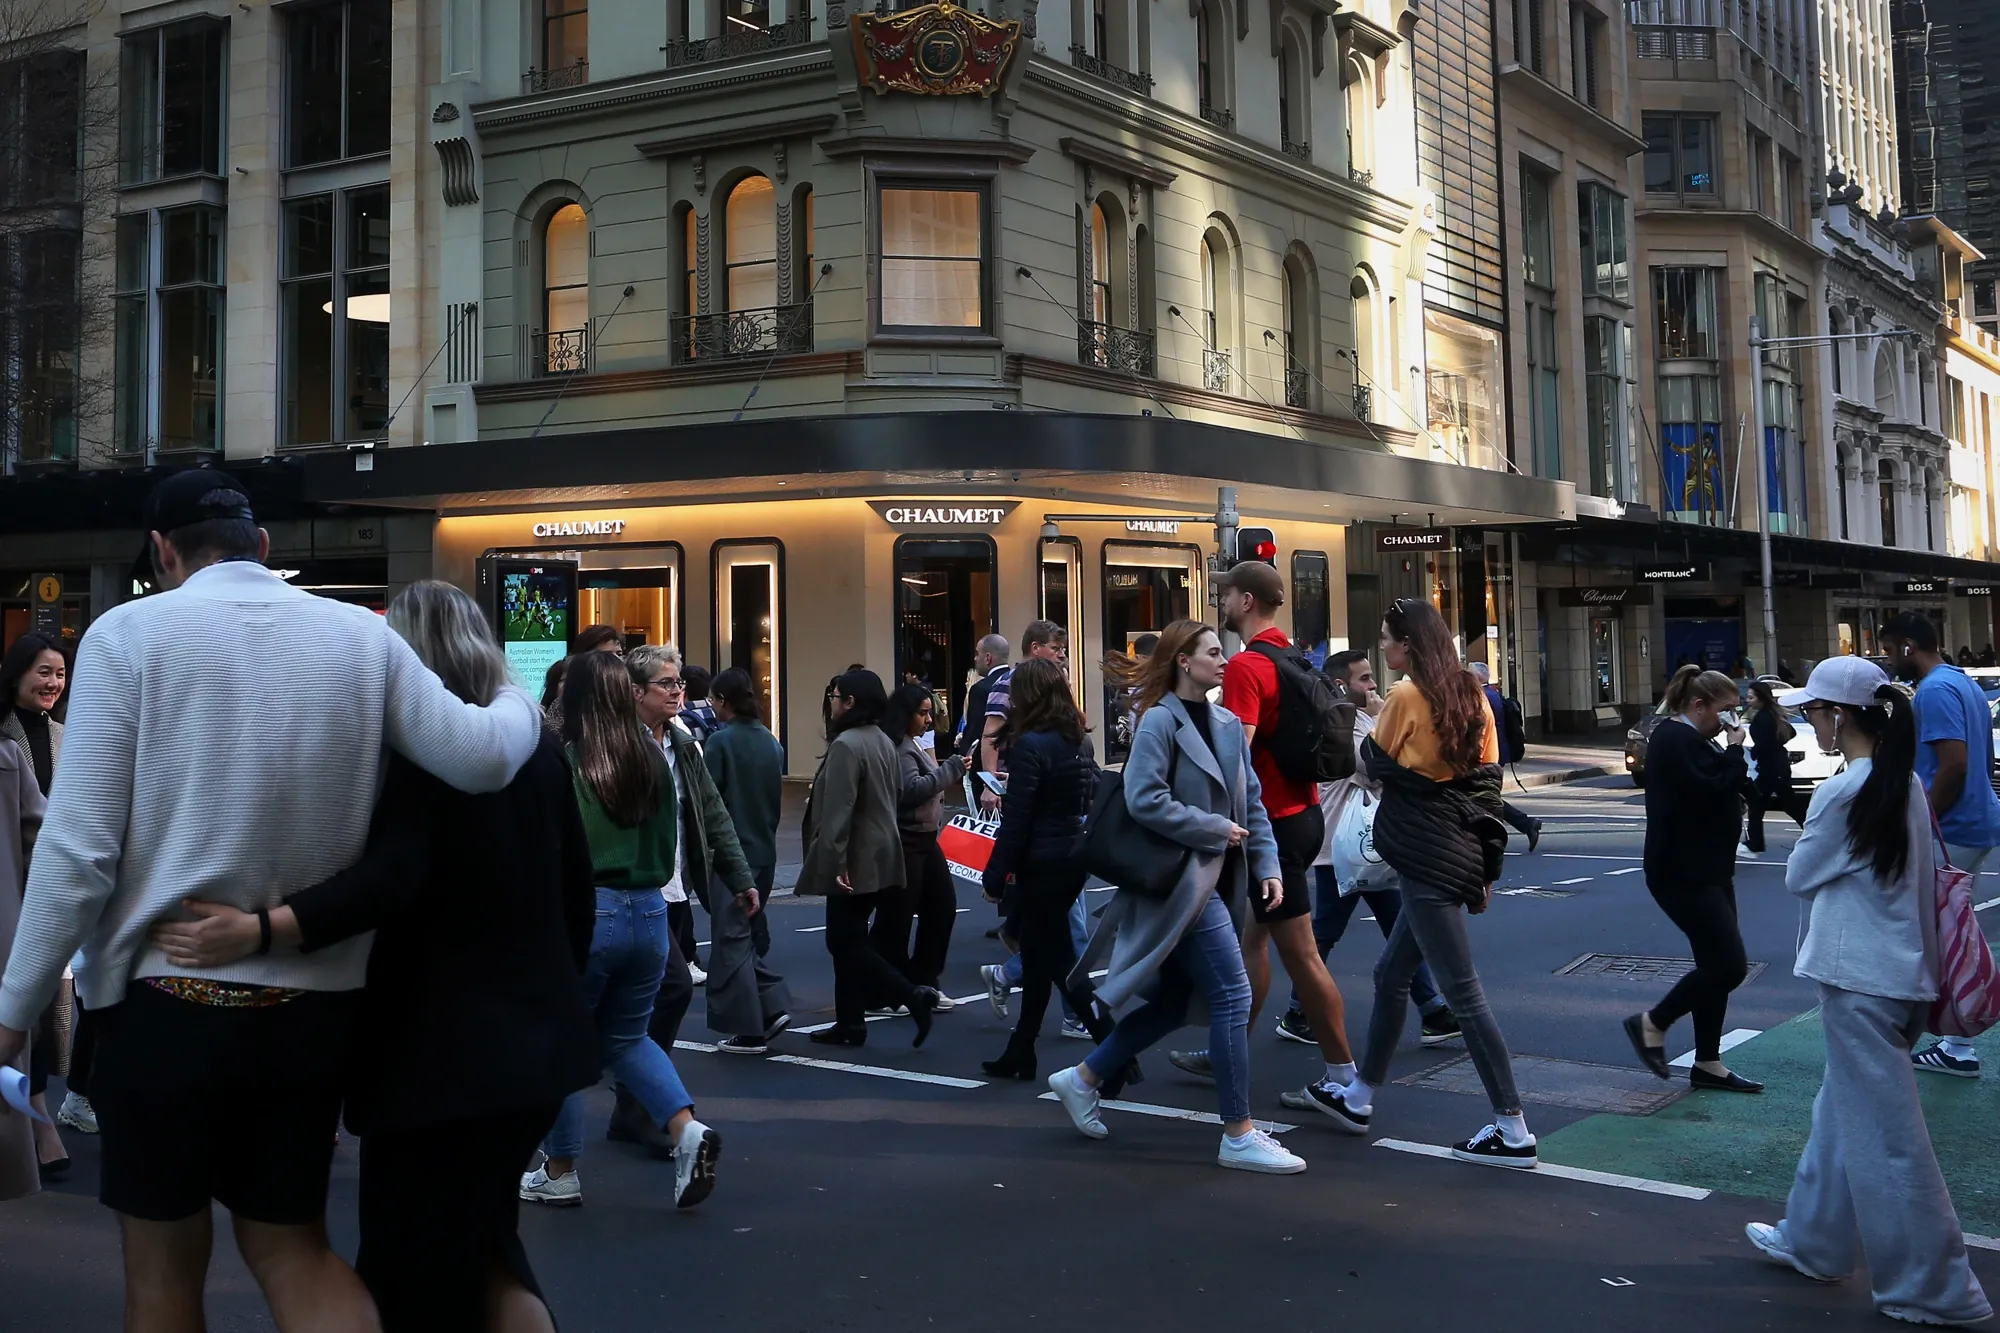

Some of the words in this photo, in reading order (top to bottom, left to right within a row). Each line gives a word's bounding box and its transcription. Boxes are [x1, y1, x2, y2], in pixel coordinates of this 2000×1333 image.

[885, 508, 1005, 523] CHAUMET
[532, 520, 625, 537] CHAUMET
[1126, 520, 1180, 534] CHAUMET
[358, 529, 373, 540] 183
[1383, 535, 1442, 545] CHAUMET
[1645, 570, 1691, 578] MONTBLANC
[1580, 589, 1627, 603] Chopard
